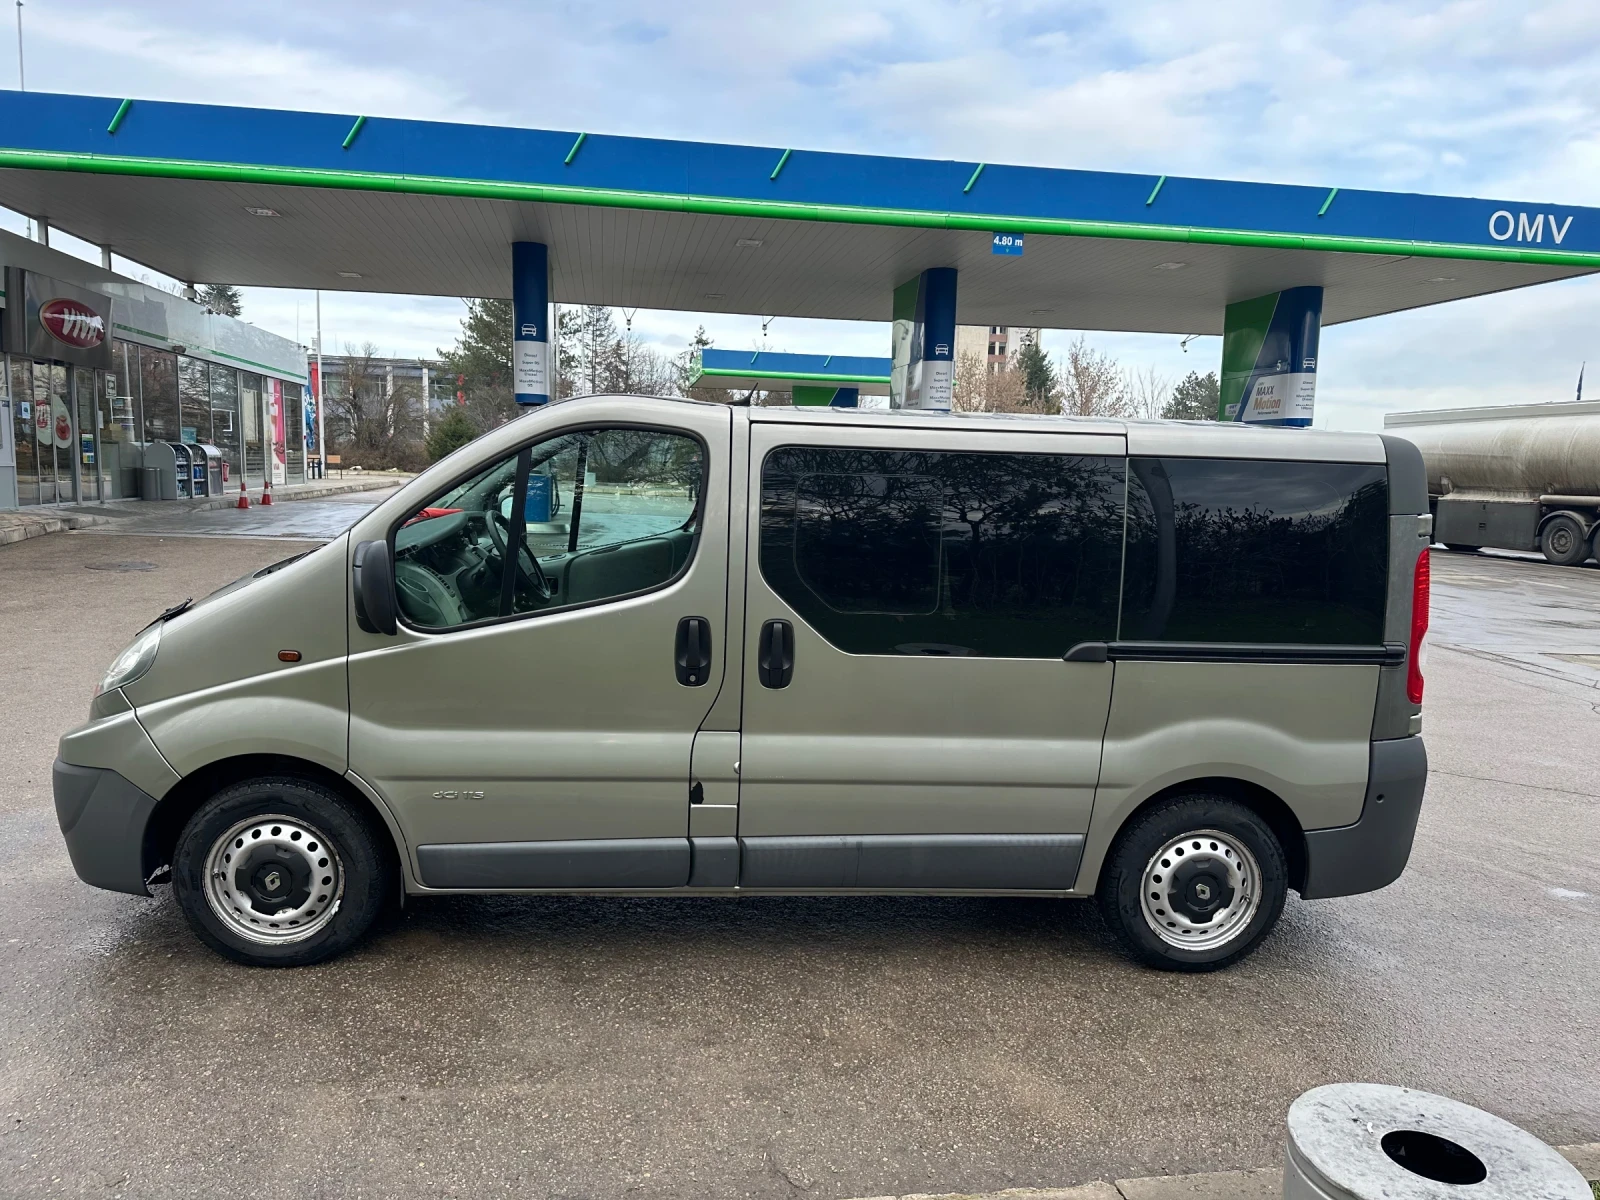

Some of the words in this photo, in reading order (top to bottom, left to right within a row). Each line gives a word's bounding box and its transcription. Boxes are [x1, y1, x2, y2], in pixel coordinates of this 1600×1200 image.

[1488, 210, 1574, 245] OMV
[993, 235, 1013, 247] 4.80
[1014, 238, 1023, 247] m
[62, 307, 98, 342] VIVA
[1276, 359, 1282, 371] 5
[1255, 385, 1275, 397] MAXX
[1252, 397, 1282, 411] Motion
[432, 790, 458, 799] dCi
